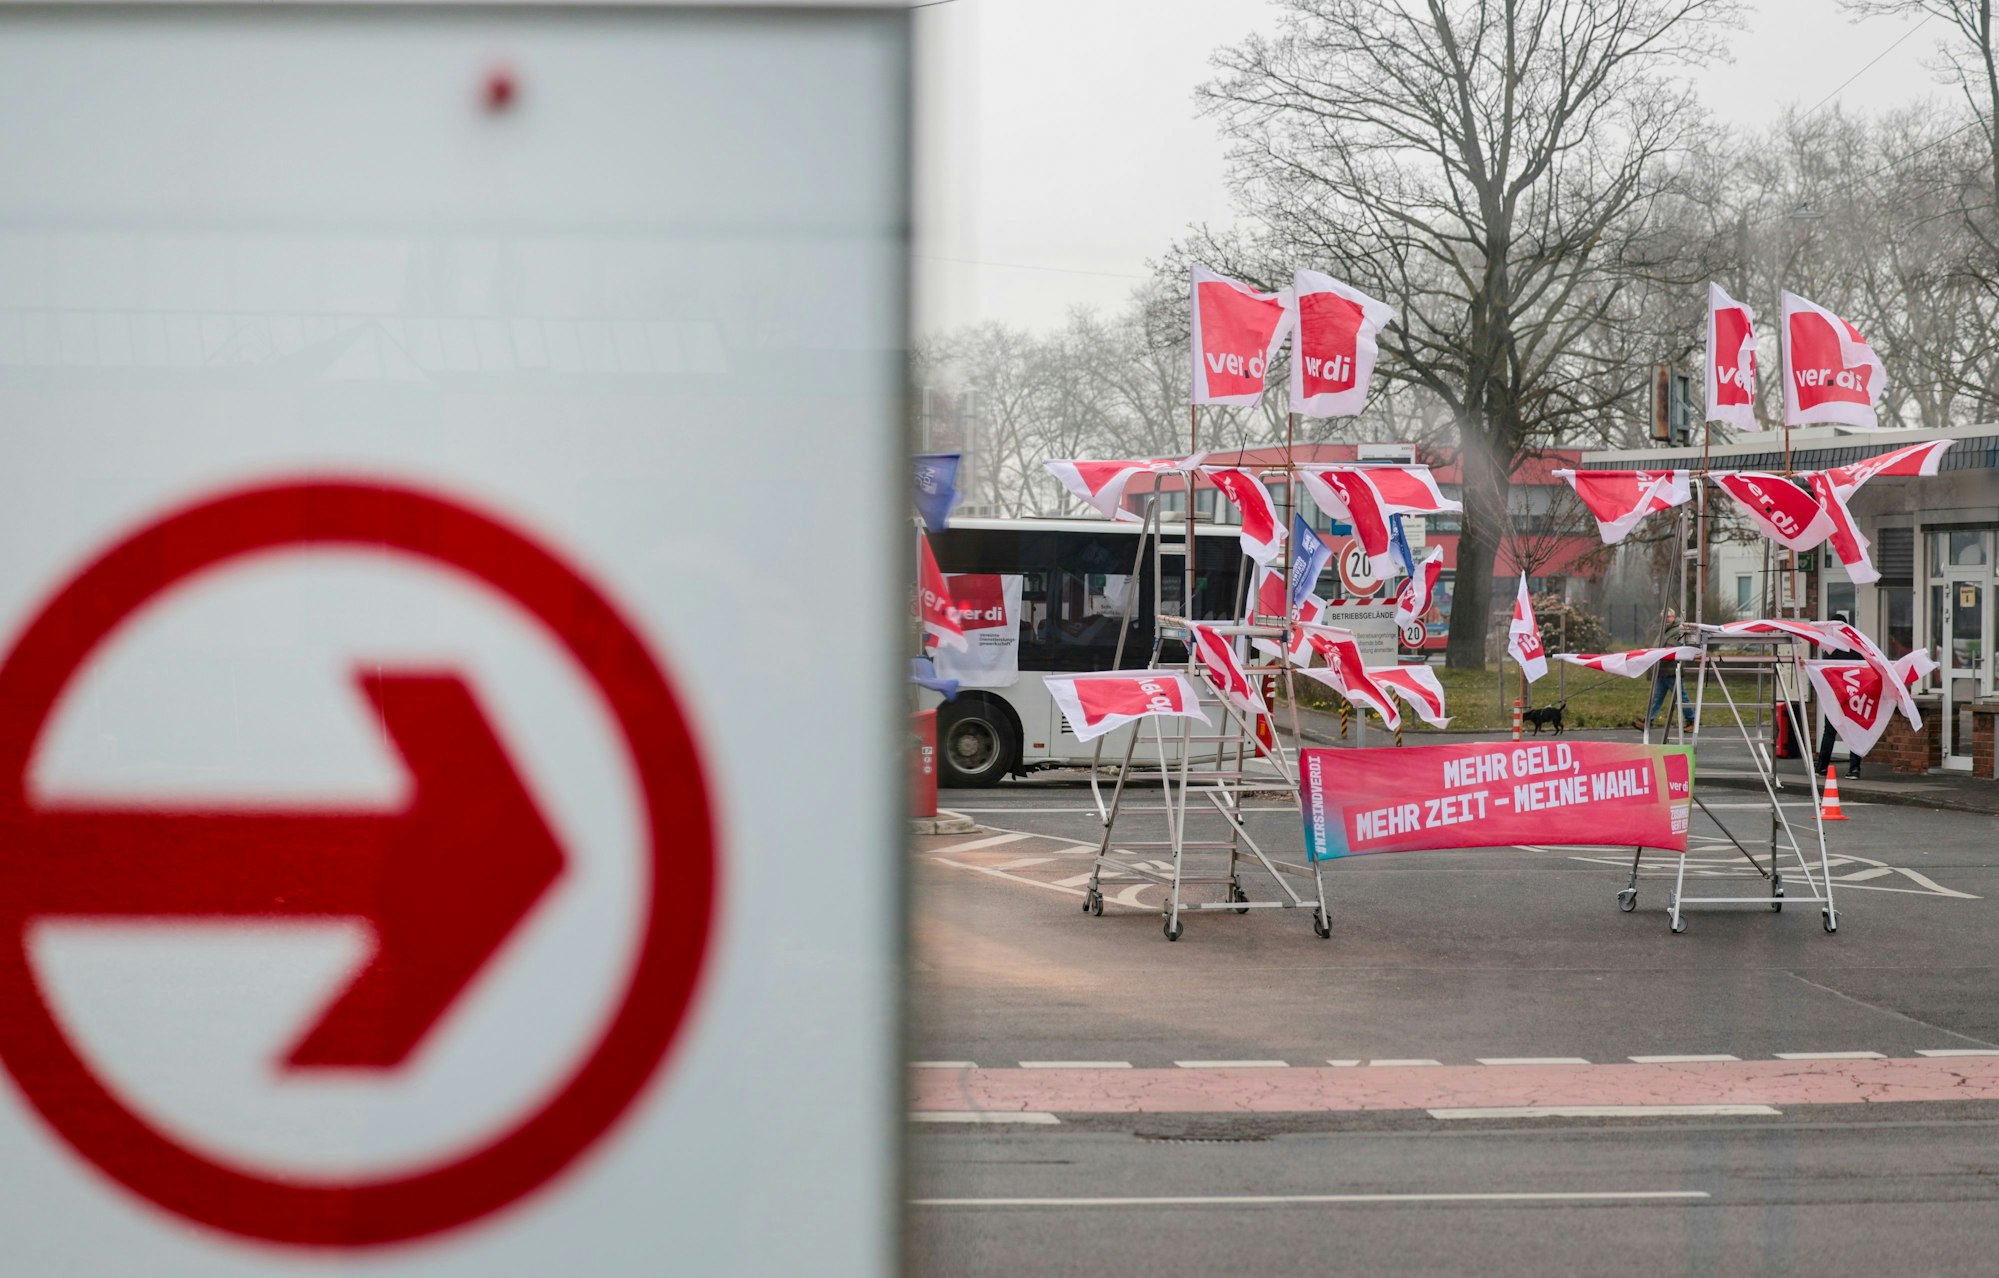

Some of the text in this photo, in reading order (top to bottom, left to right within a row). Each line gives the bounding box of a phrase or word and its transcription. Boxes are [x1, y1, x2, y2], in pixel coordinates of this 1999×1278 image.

[1305, 355, 1351, 382] ver.di
[1351, 552, 1371, 577] 20
[1332, 611, 1395, 620] BETRIEBSGELÄNDE
[1407, 627, 1420, 640] 20
[1444, 743, 1580, 789] MEHR GELD,
[1309, 756, 1327, 854] #WIRSINDVERDI
[1356, 803, 1421, 842] MEHR
[1425, 790, 1489, 828] ZEIT
[1514, 776, 1589, 813] MEINE
[1591, 767, 1650, 801] WAHL!
